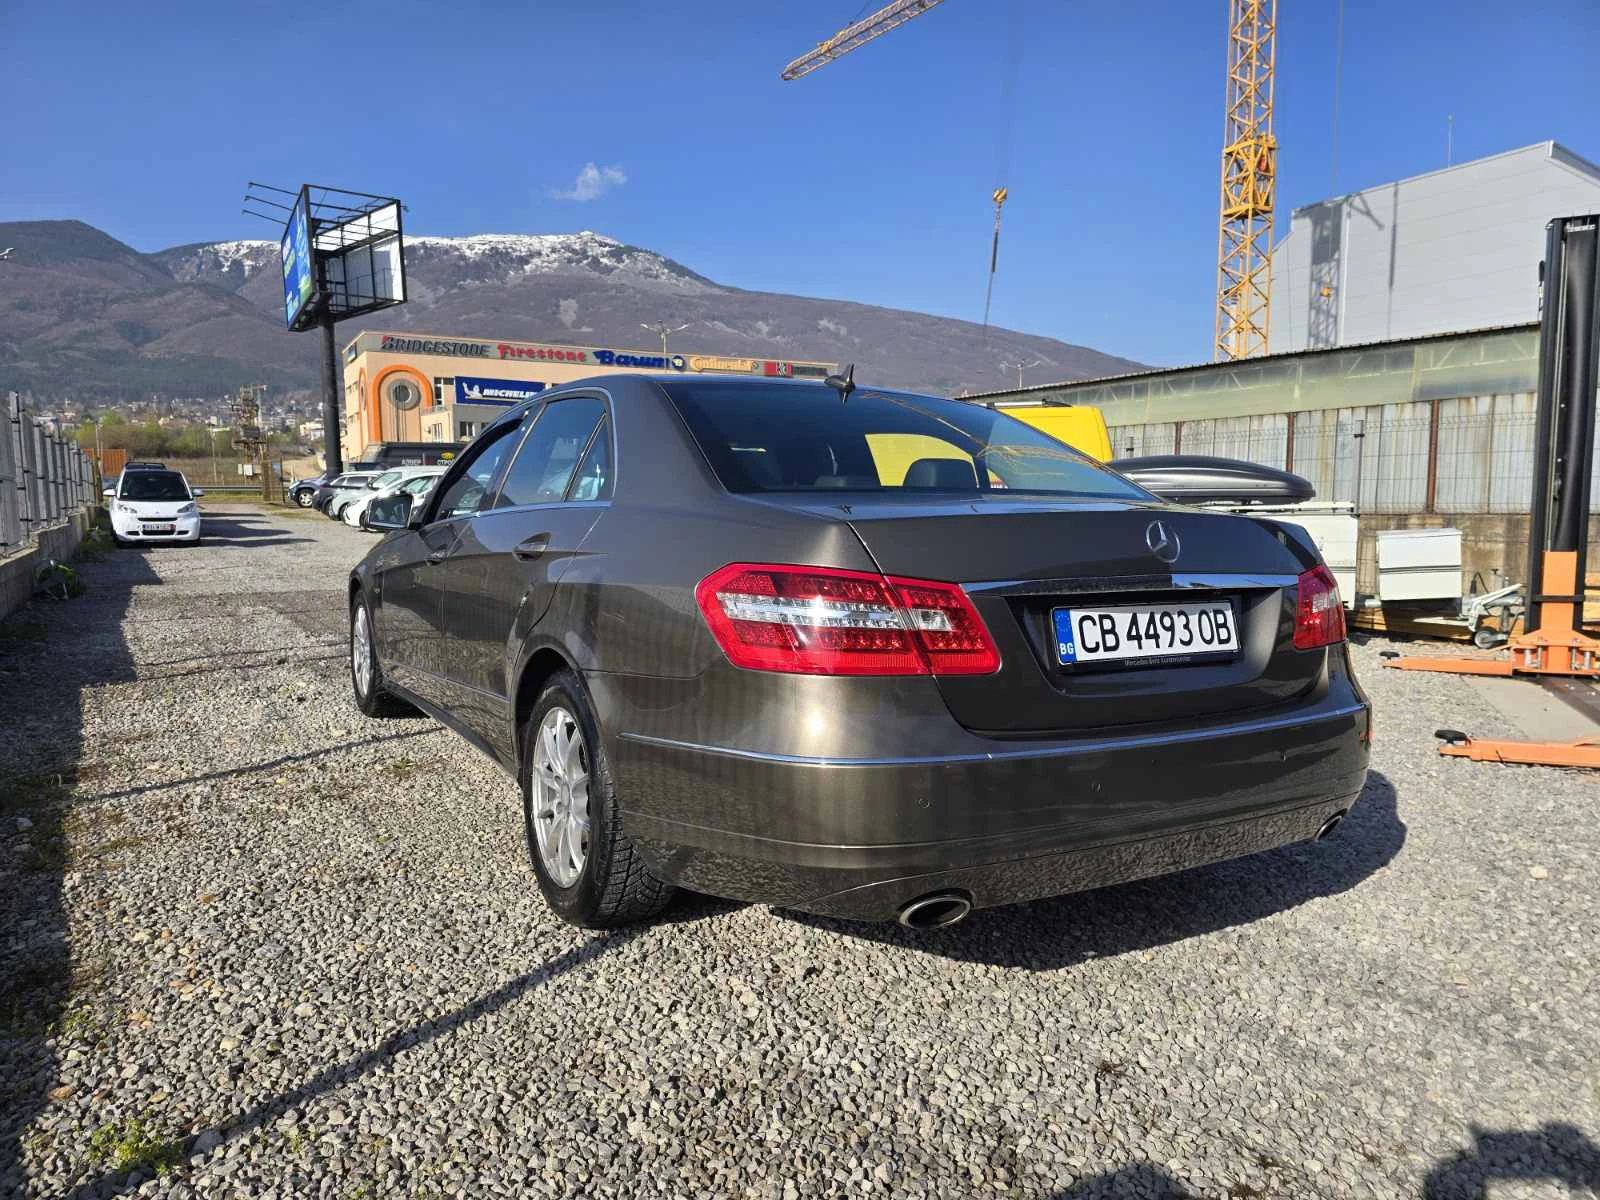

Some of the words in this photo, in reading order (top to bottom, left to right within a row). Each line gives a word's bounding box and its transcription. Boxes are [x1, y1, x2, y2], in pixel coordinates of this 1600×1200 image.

[381, 335, 491, 357] BRIDGESTONE
[497, 343, 587, 361] Firestone
[592, 350, 670, 368] Barum
[689, 356, 753, 372] Continental
[1078, 613, 1120, 653] CB
[1126, 611, 1194, 650] 4493
[1059, 642, 1074, 655] BG
